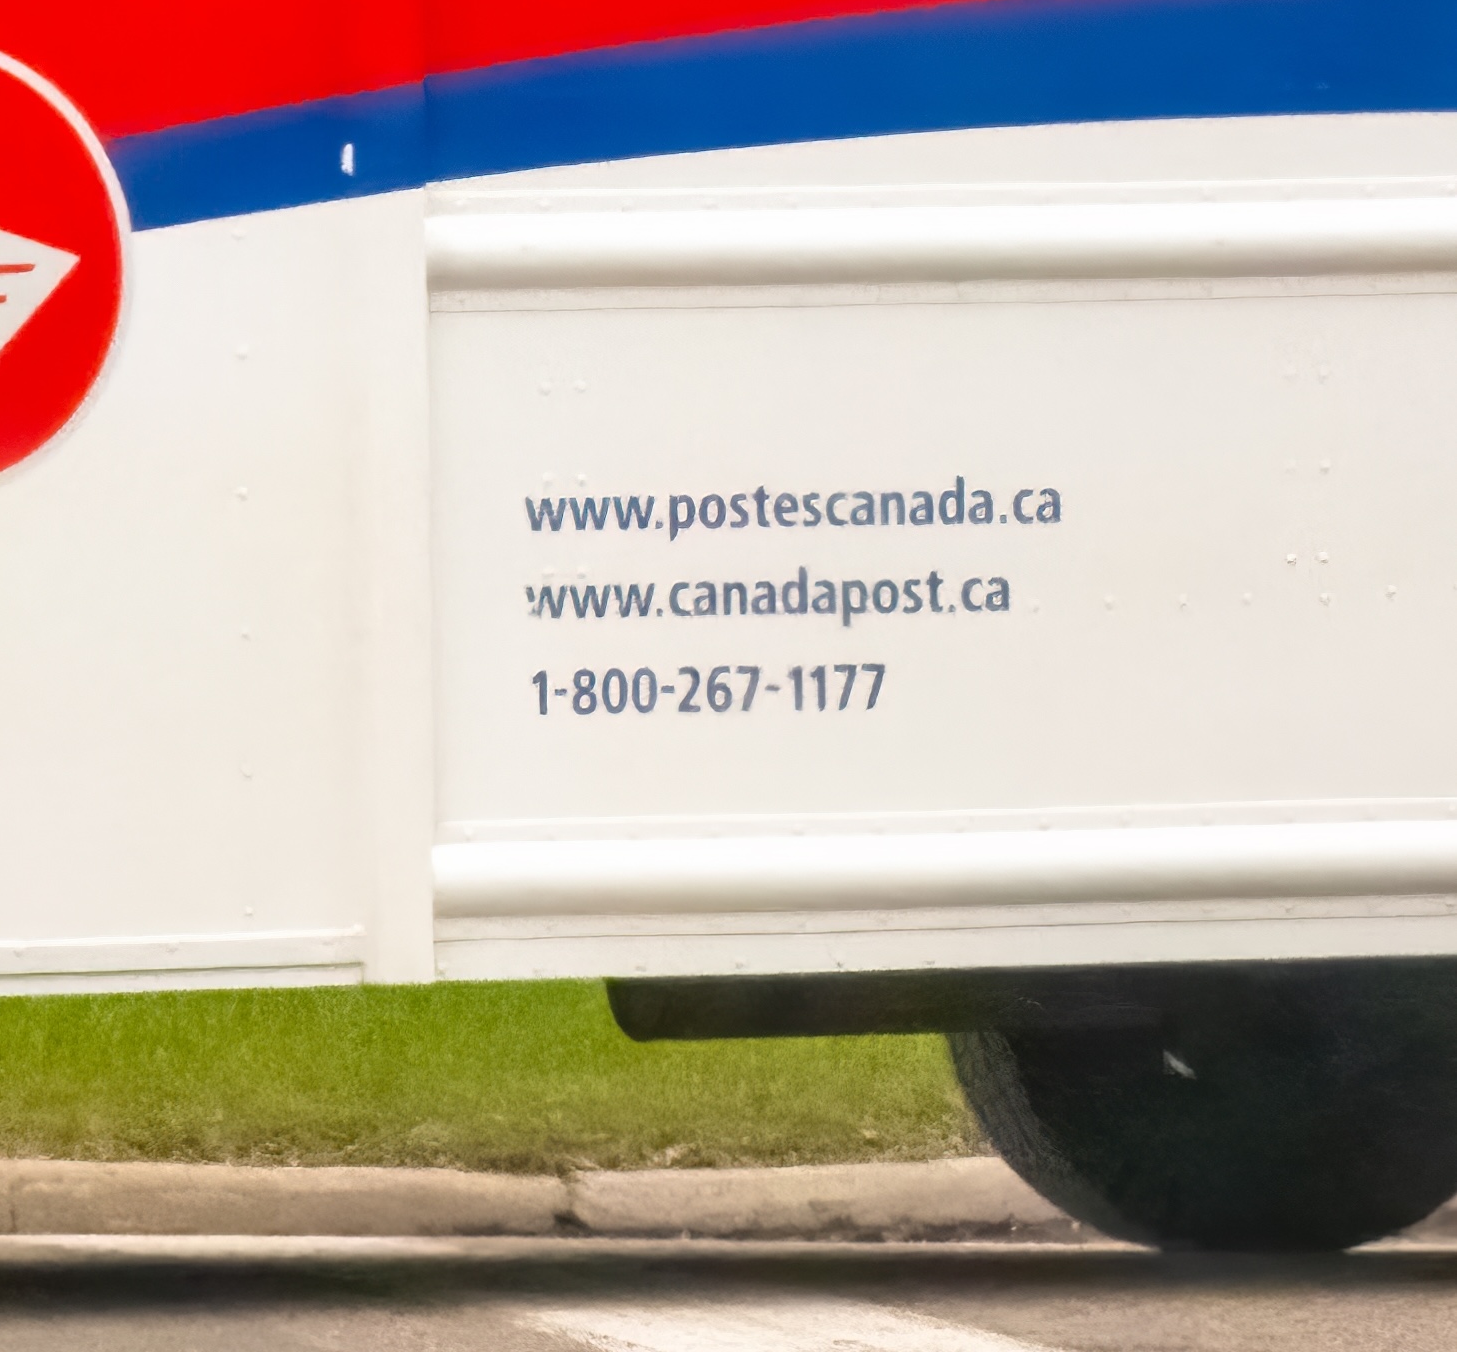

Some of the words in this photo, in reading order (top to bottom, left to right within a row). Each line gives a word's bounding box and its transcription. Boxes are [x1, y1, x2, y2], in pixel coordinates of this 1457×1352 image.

[525, 475, 1063, 541] www.postescanada.ca
[525, 565, 1012, 627] www.canadapost.ca
[531, 663, 887, 716] 1-800-267-1177
